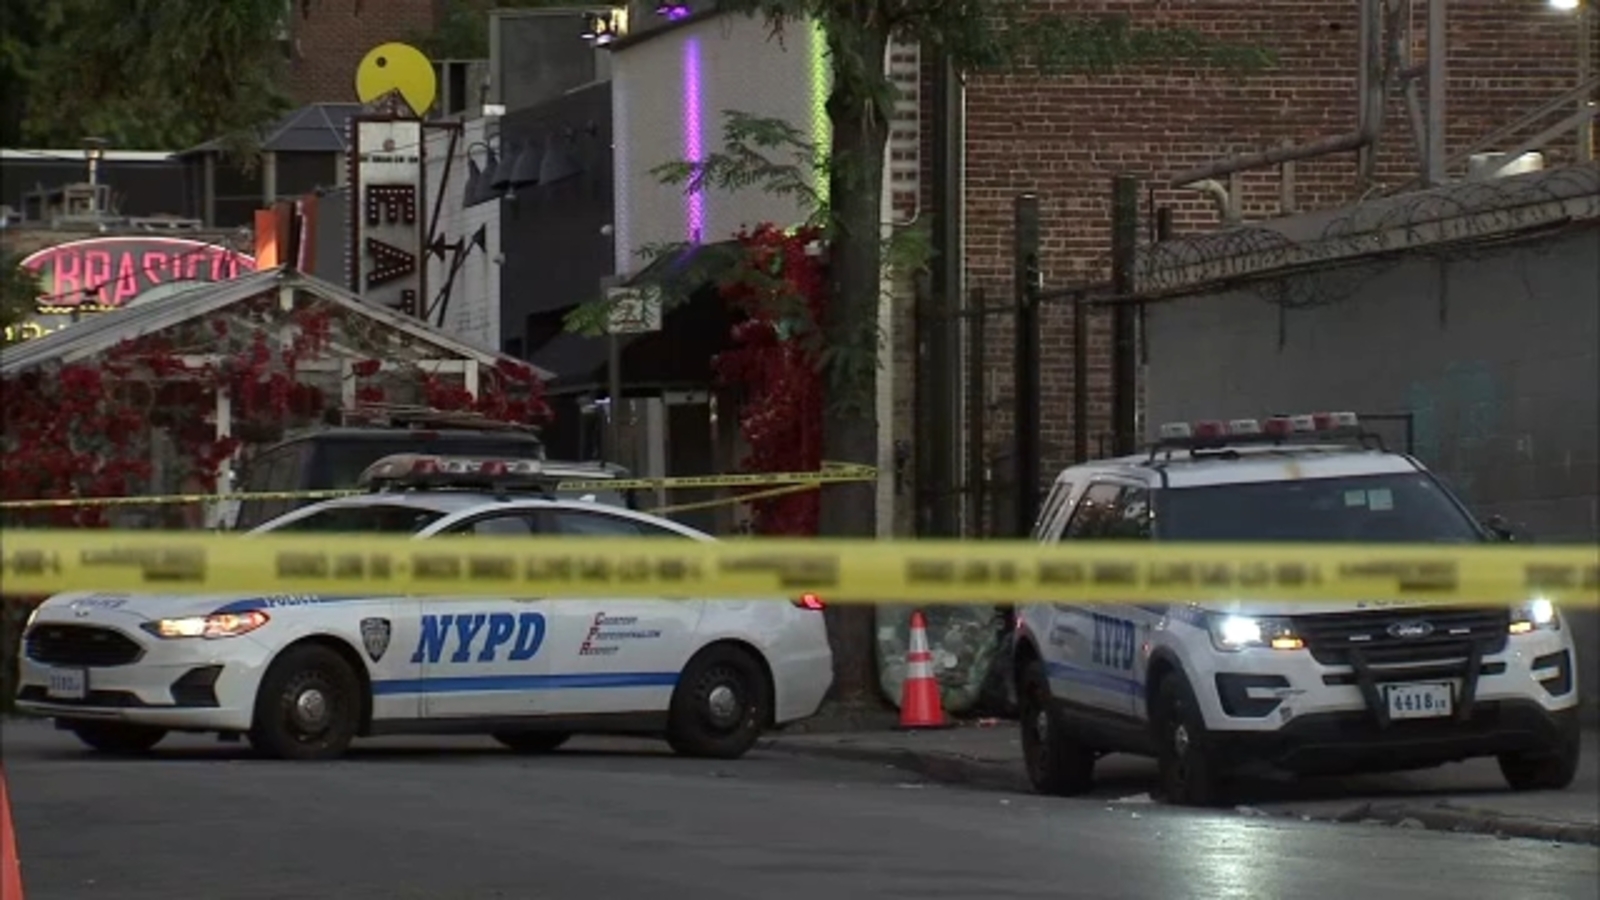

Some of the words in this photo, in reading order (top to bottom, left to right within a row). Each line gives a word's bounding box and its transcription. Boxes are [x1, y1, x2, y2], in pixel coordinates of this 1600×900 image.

[410, 612, 546, 663] NYPD
[1092, 612, 1136, 670] NYPD
[1393, 692, 1433, 711] 4418
